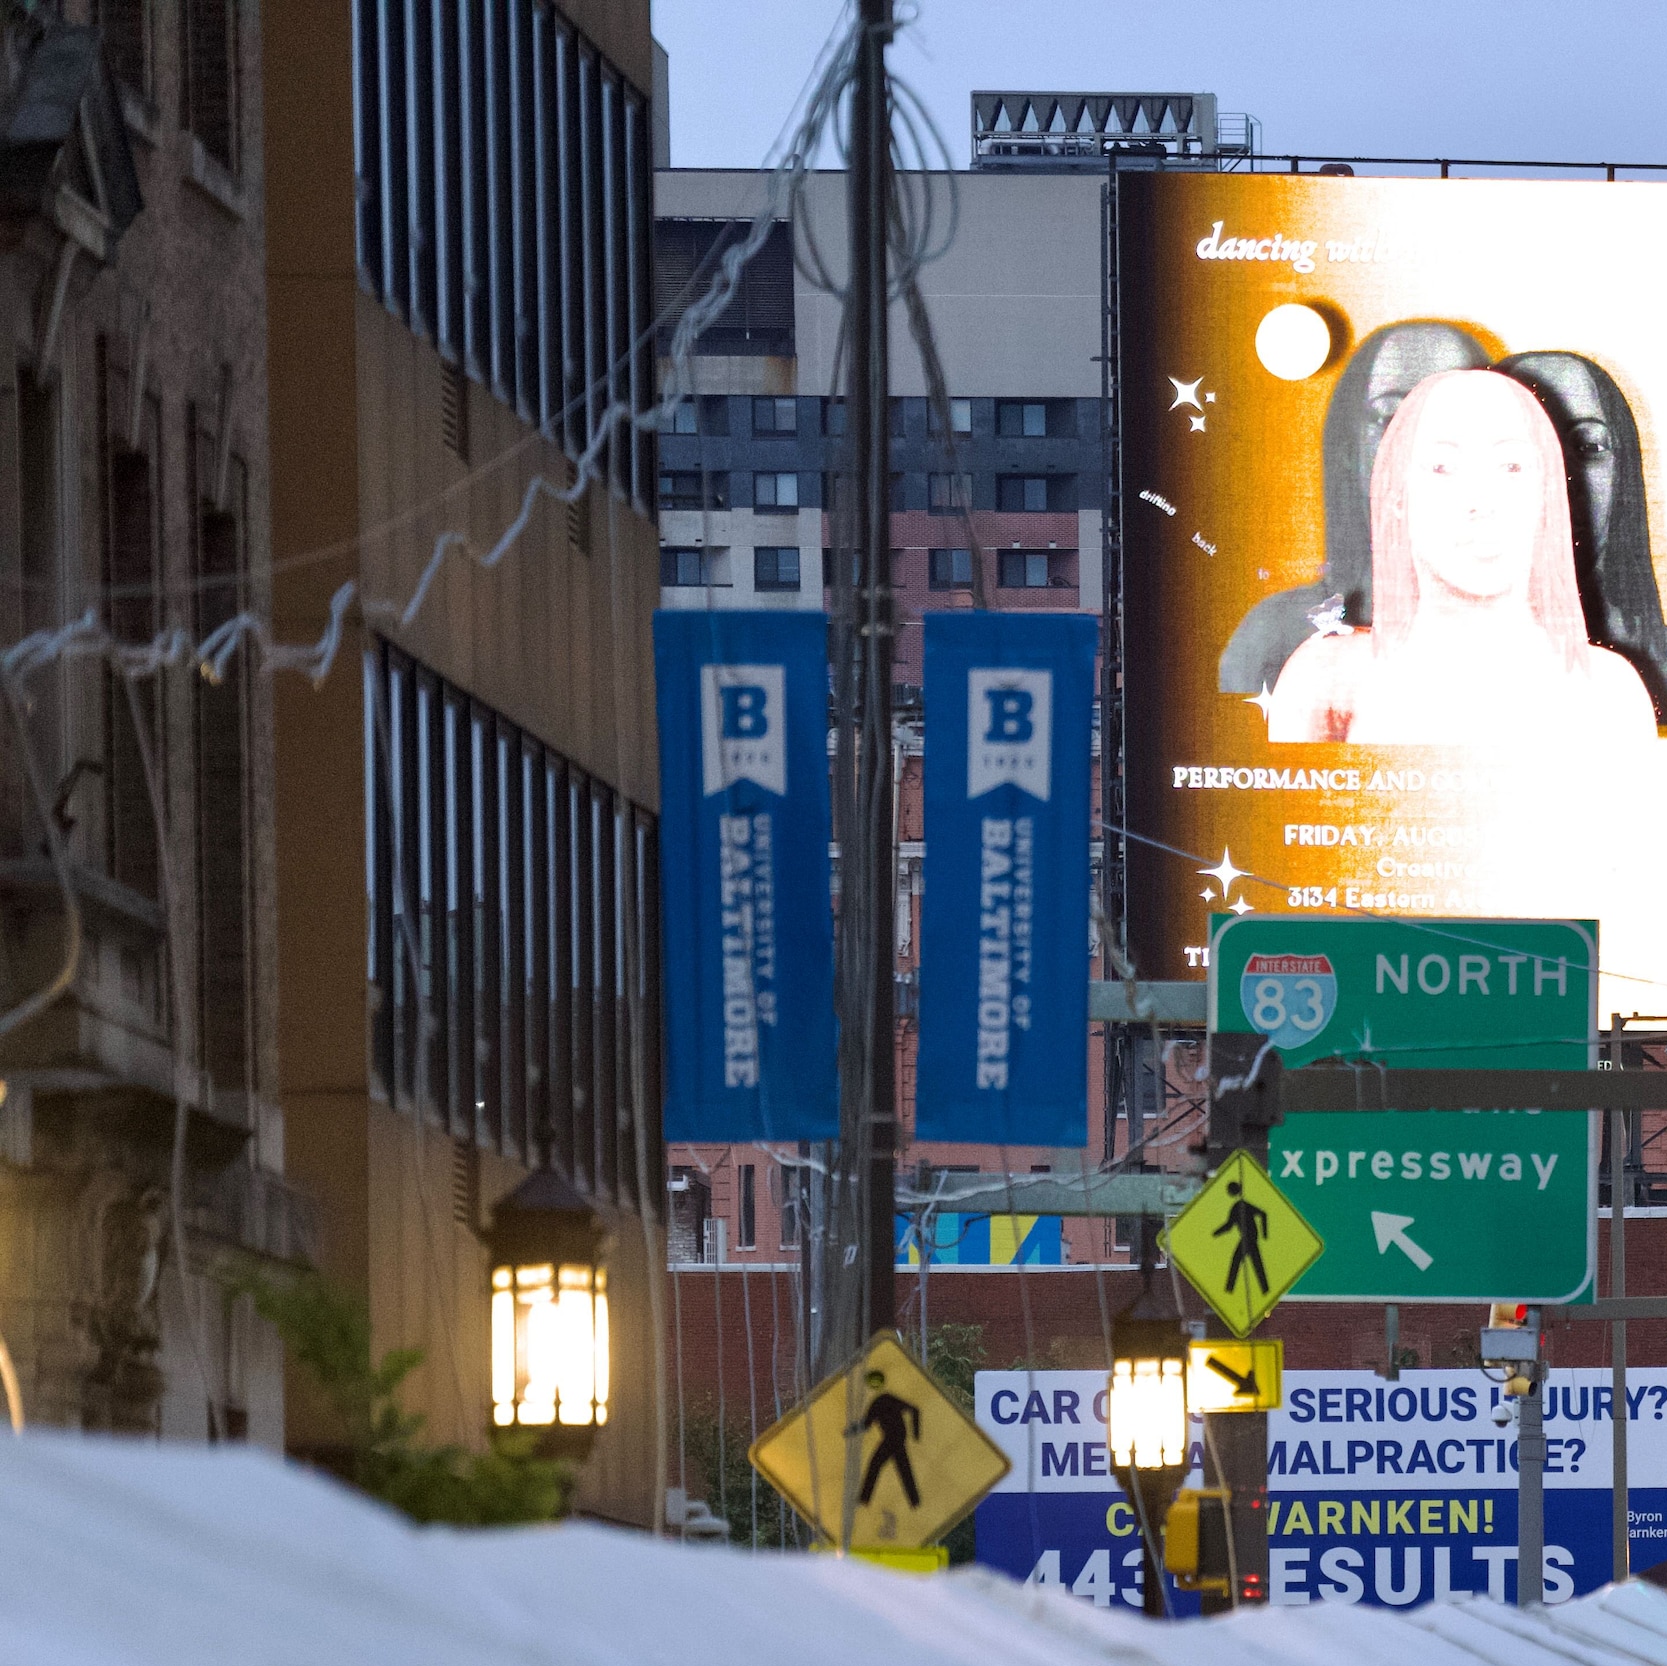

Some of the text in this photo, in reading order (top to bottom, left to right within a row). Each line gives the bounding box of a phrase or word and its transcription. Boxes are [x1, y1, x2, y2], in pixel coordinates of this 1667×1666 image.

[1196, 220, 1318, 274] dancing
[1191, 531, 1218, 557] back
[719, 684, 769, 739] B
[983, 686, 1034, 744] B
[1172, 766, 1360, 792] PERFORMANCE
[1367, 770, 1426, 792] AND
[1283, 824, 1384, 848] FRIDAY,
[752, 814, 779, 1028] UNIVERSITY OF
[1286, 886, 1338, 909] 3134
[1346, 889, 1436, 910] Eastern
[1011, 816, 1034, 1032] UNIVERSITY OF
[718, 813, 759, 1089] BALTIMORE
[975, 816, 1013, 1090] BALTIMORE
[1254, 960, 1322, 974] INTERSTATE
[1375, 953, 1568, 997] NORTH
[1252, 978, 1325, 1031] 83
[1267, 1142, 1559, 1191] xpressway
[990, 1389, 1081, 1425] CAR
[1288, 1386, 1478, 1423] SERIOUS
[1627, 1511, 1663, 1525] Byron
